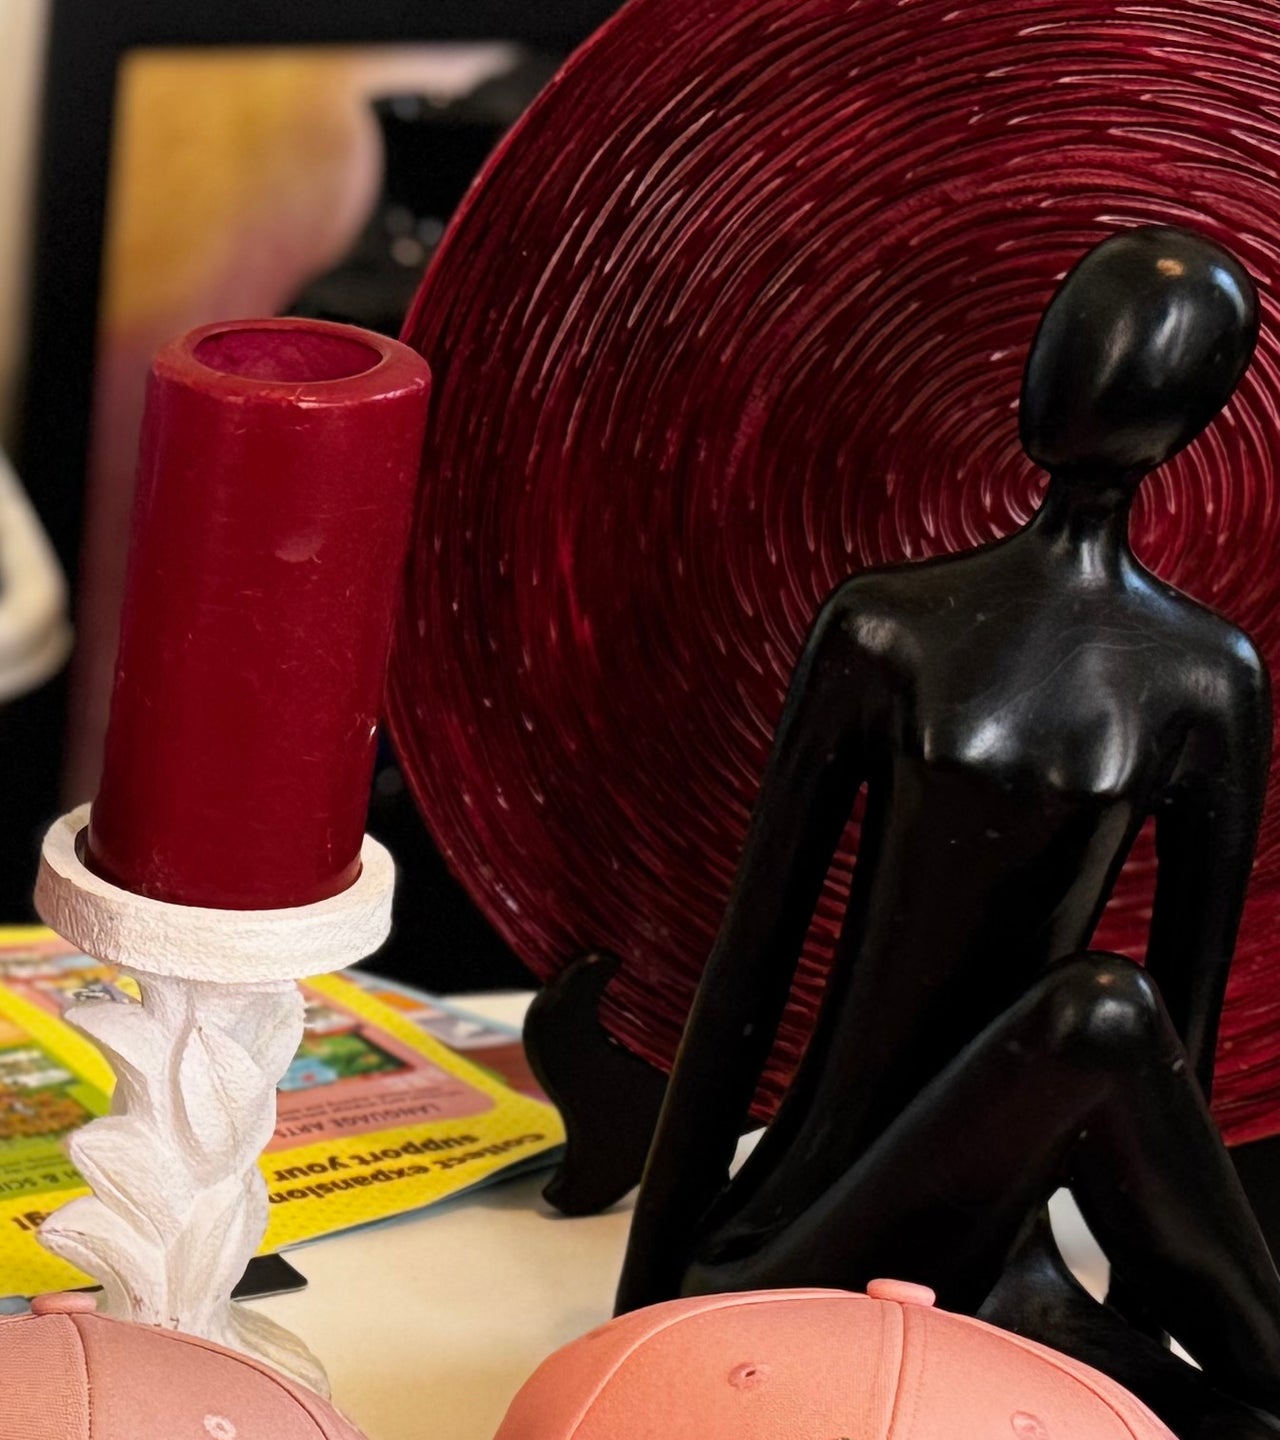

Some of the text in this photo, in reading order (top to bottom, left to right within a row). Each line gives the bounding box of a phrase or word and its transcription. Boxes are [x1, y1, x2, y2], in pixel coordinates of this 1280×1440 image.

[330, 1103, 441, 1129] LANGUAGE
[274, 1135, 480, 1183] support your
[267, 1166, 430, 1205] expansion
